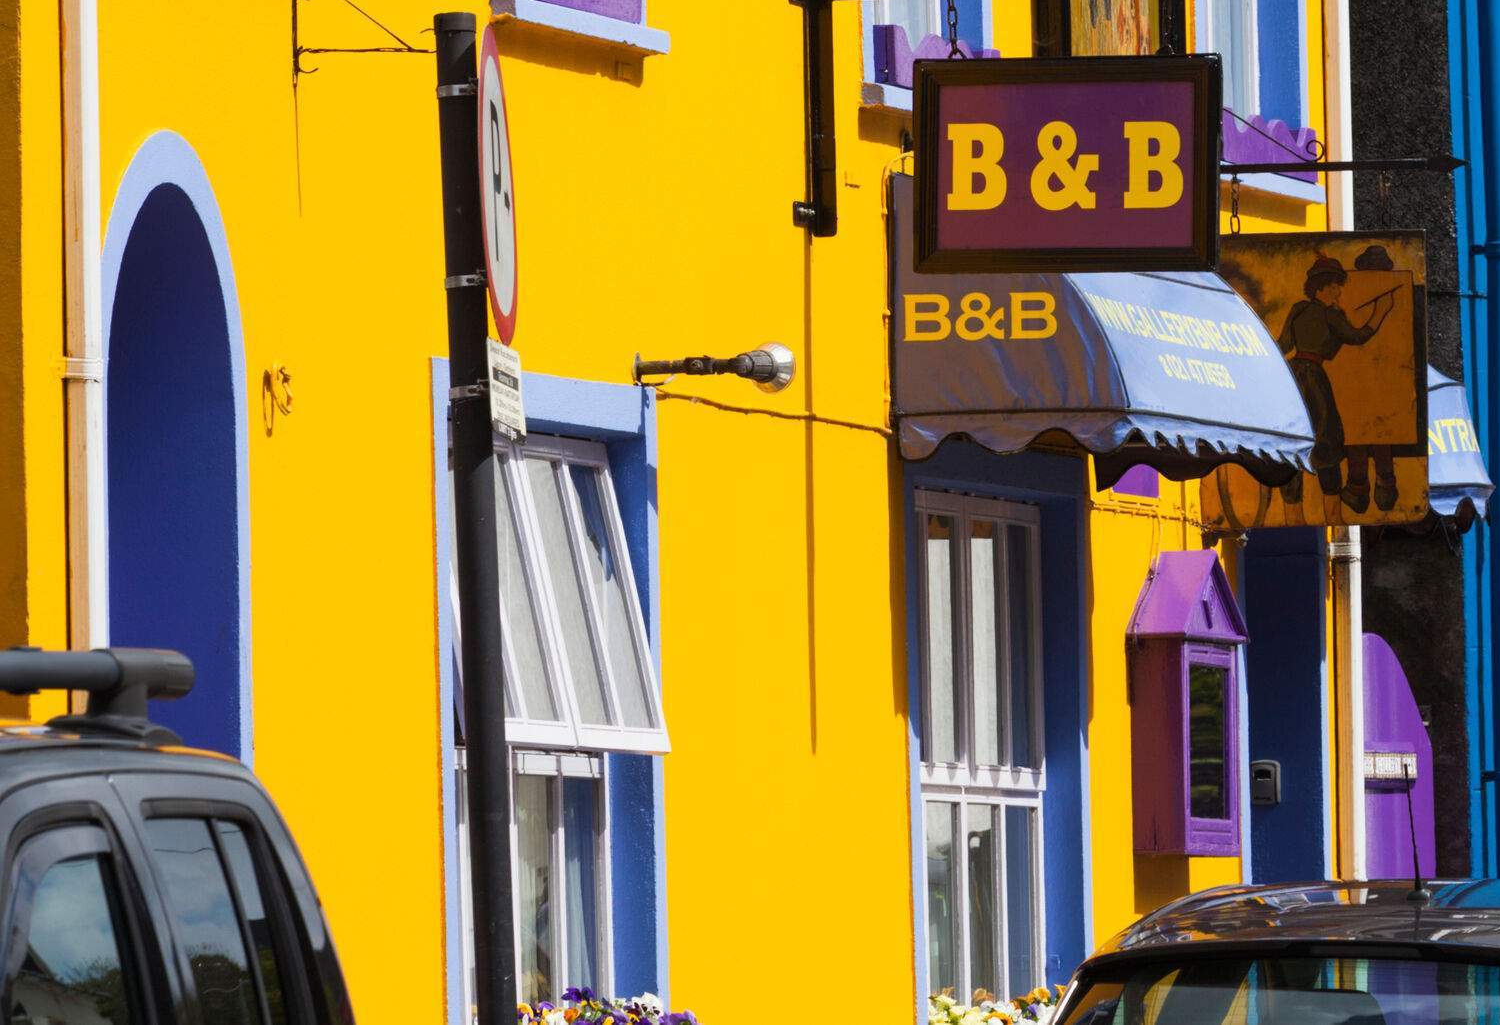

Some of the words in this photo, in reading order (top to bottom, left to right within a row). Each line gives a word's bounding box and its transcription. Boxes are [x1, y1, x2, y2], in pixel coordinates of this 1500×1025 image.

[490, 99, 502, 263] P
[947, 123, 1007, 210] B
[1030, 121, 1099, 211] &
[1124, 121, 1184, 209] B
[903, 291, 1057, 342] B&B
